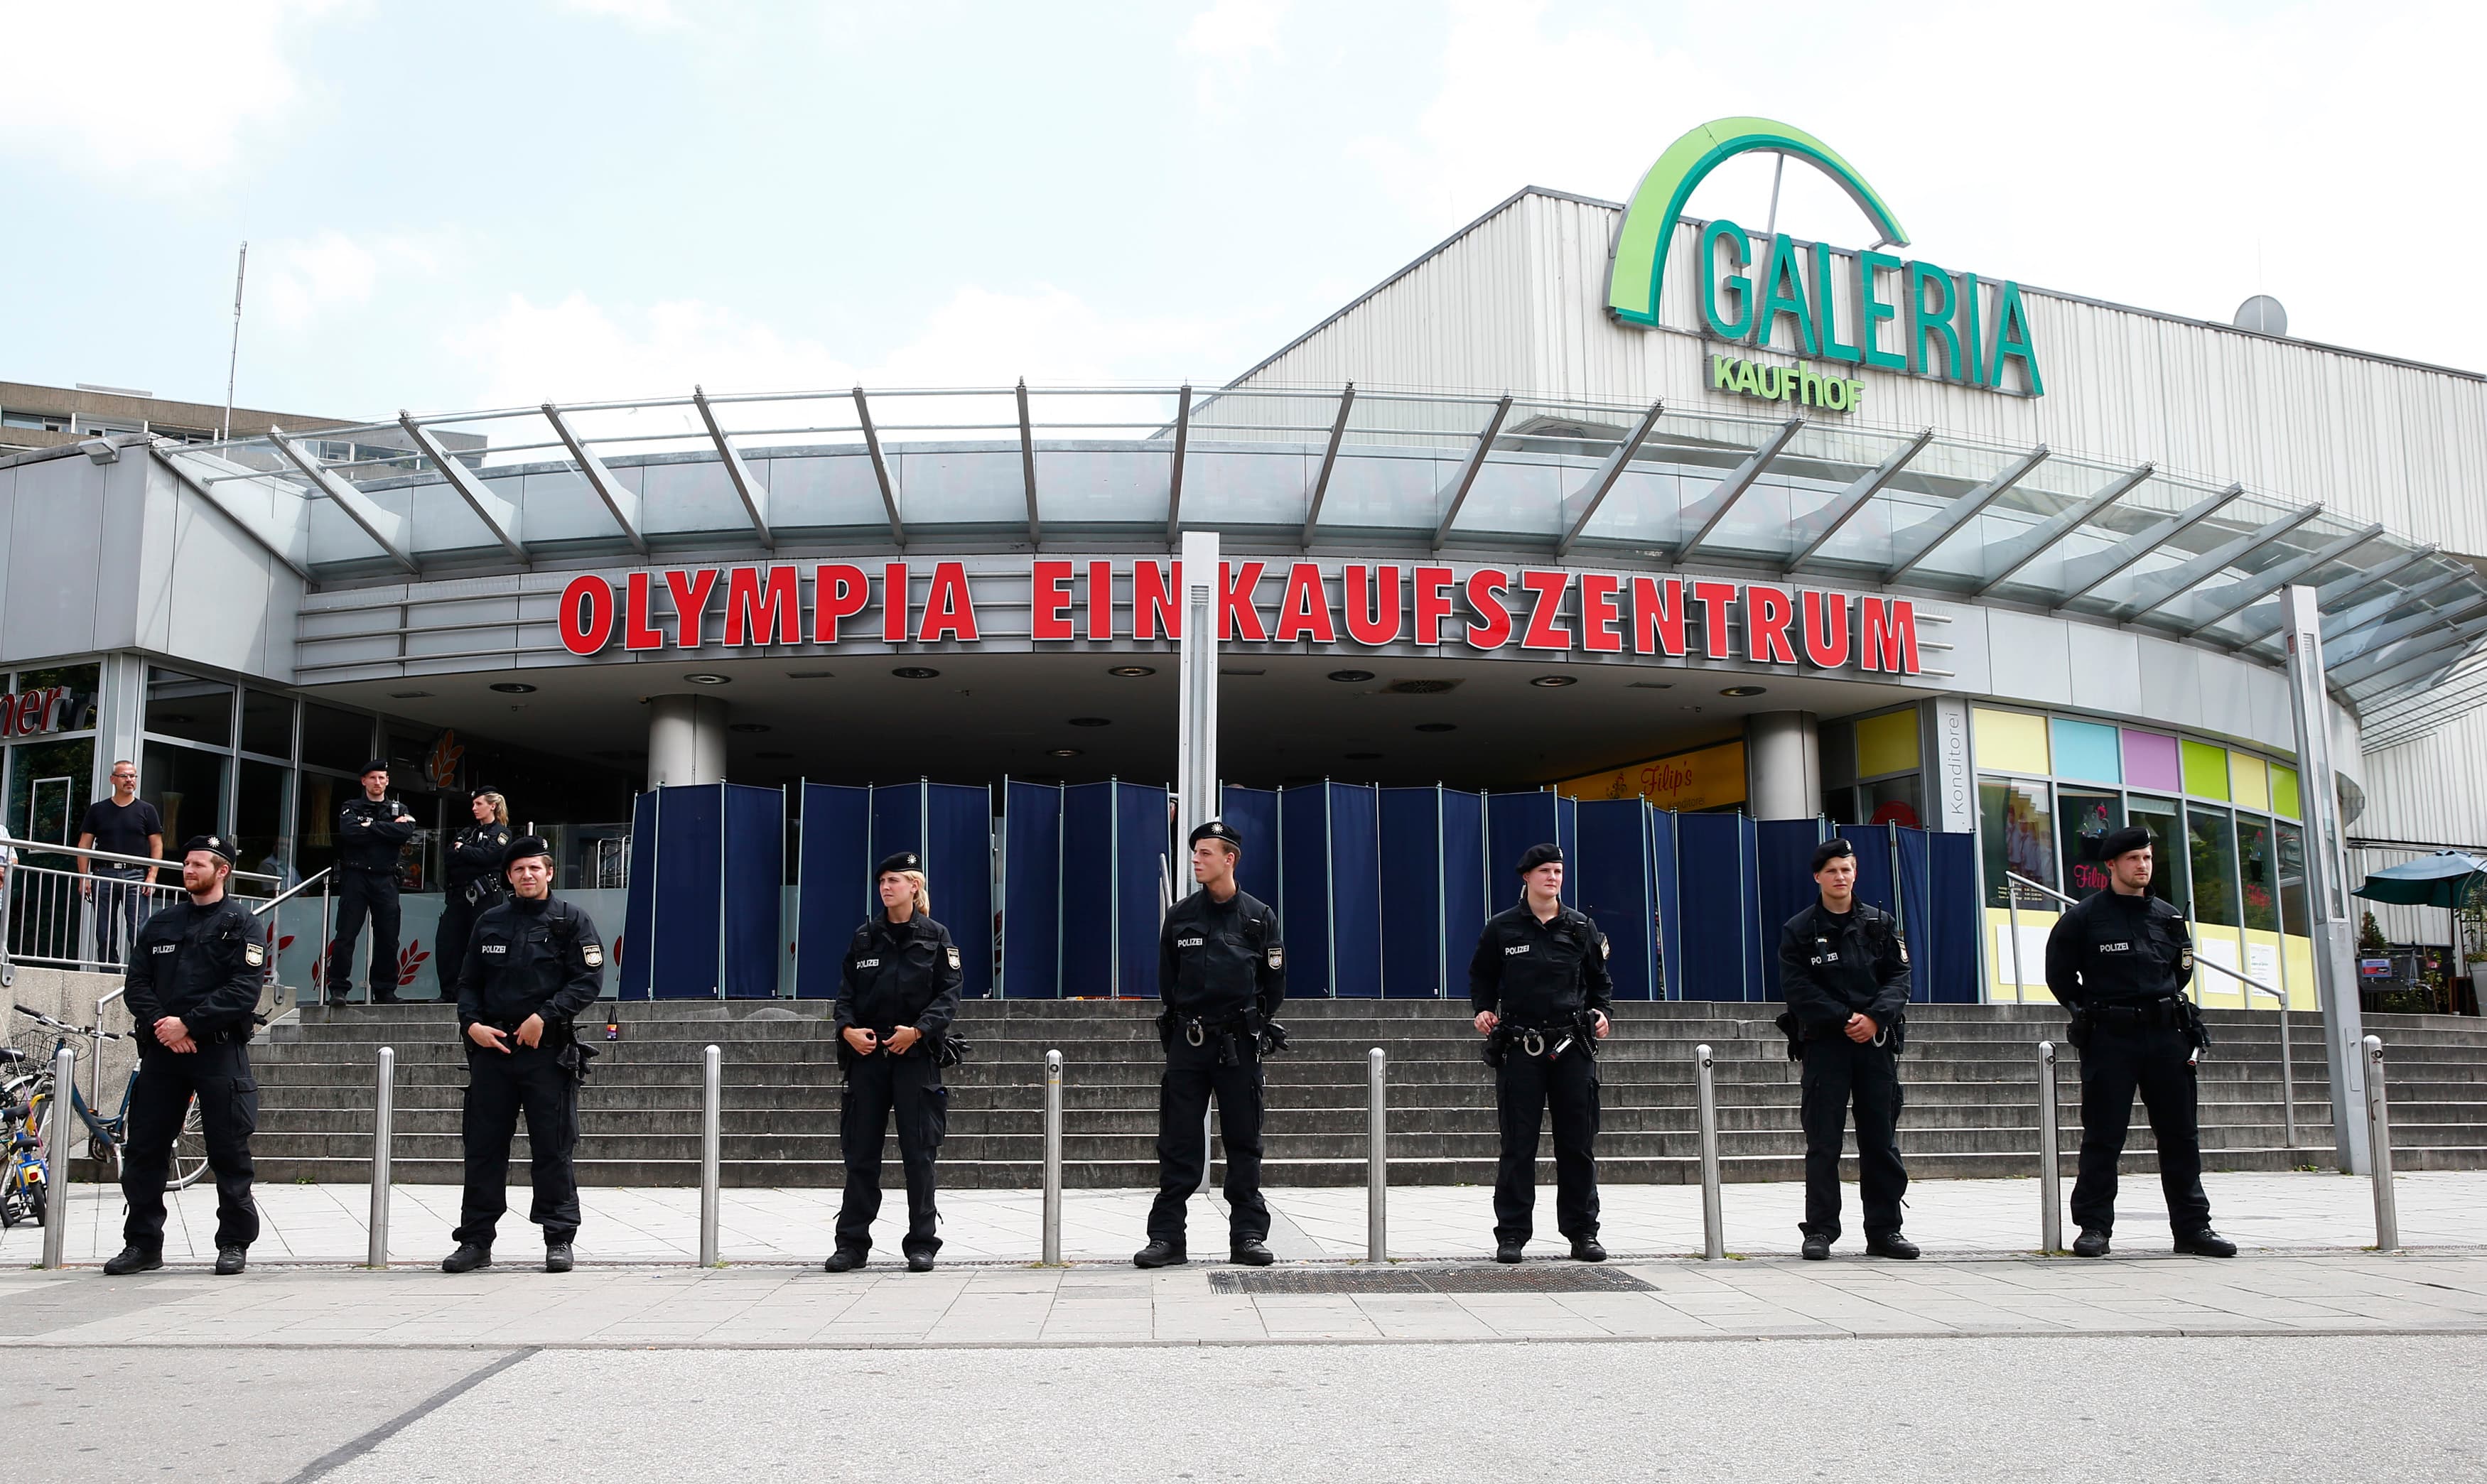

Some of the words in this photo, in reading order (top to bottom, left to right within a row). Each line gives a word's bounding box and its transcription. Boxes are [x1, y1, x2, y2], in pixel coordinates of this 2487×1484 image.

[1698, 219, 2044, 399] GALERIA
[557, 560, 981, 657] OLYMPIA
[1031, 559, 1921, 676] EINKAUFSZENTRUM
[1945, 712, 1965, 814] Konditorei
[1640, 761, 1693, 796] Filip's
[2073, 864, 2108, 891] Filip
[482, 945, 506, 953] POLIZEI
[1177, 938, 1203, 948] POLIZEI
[2100, 942, 2129, 953] POLIZEI
[153, 944, 176, 955] POLIZEI
[1505, 945, 1530, 955] POLIZEI
[856, 958, 880, 969] POLIZEI
[1811, 952, 1839, 965] POZEI
